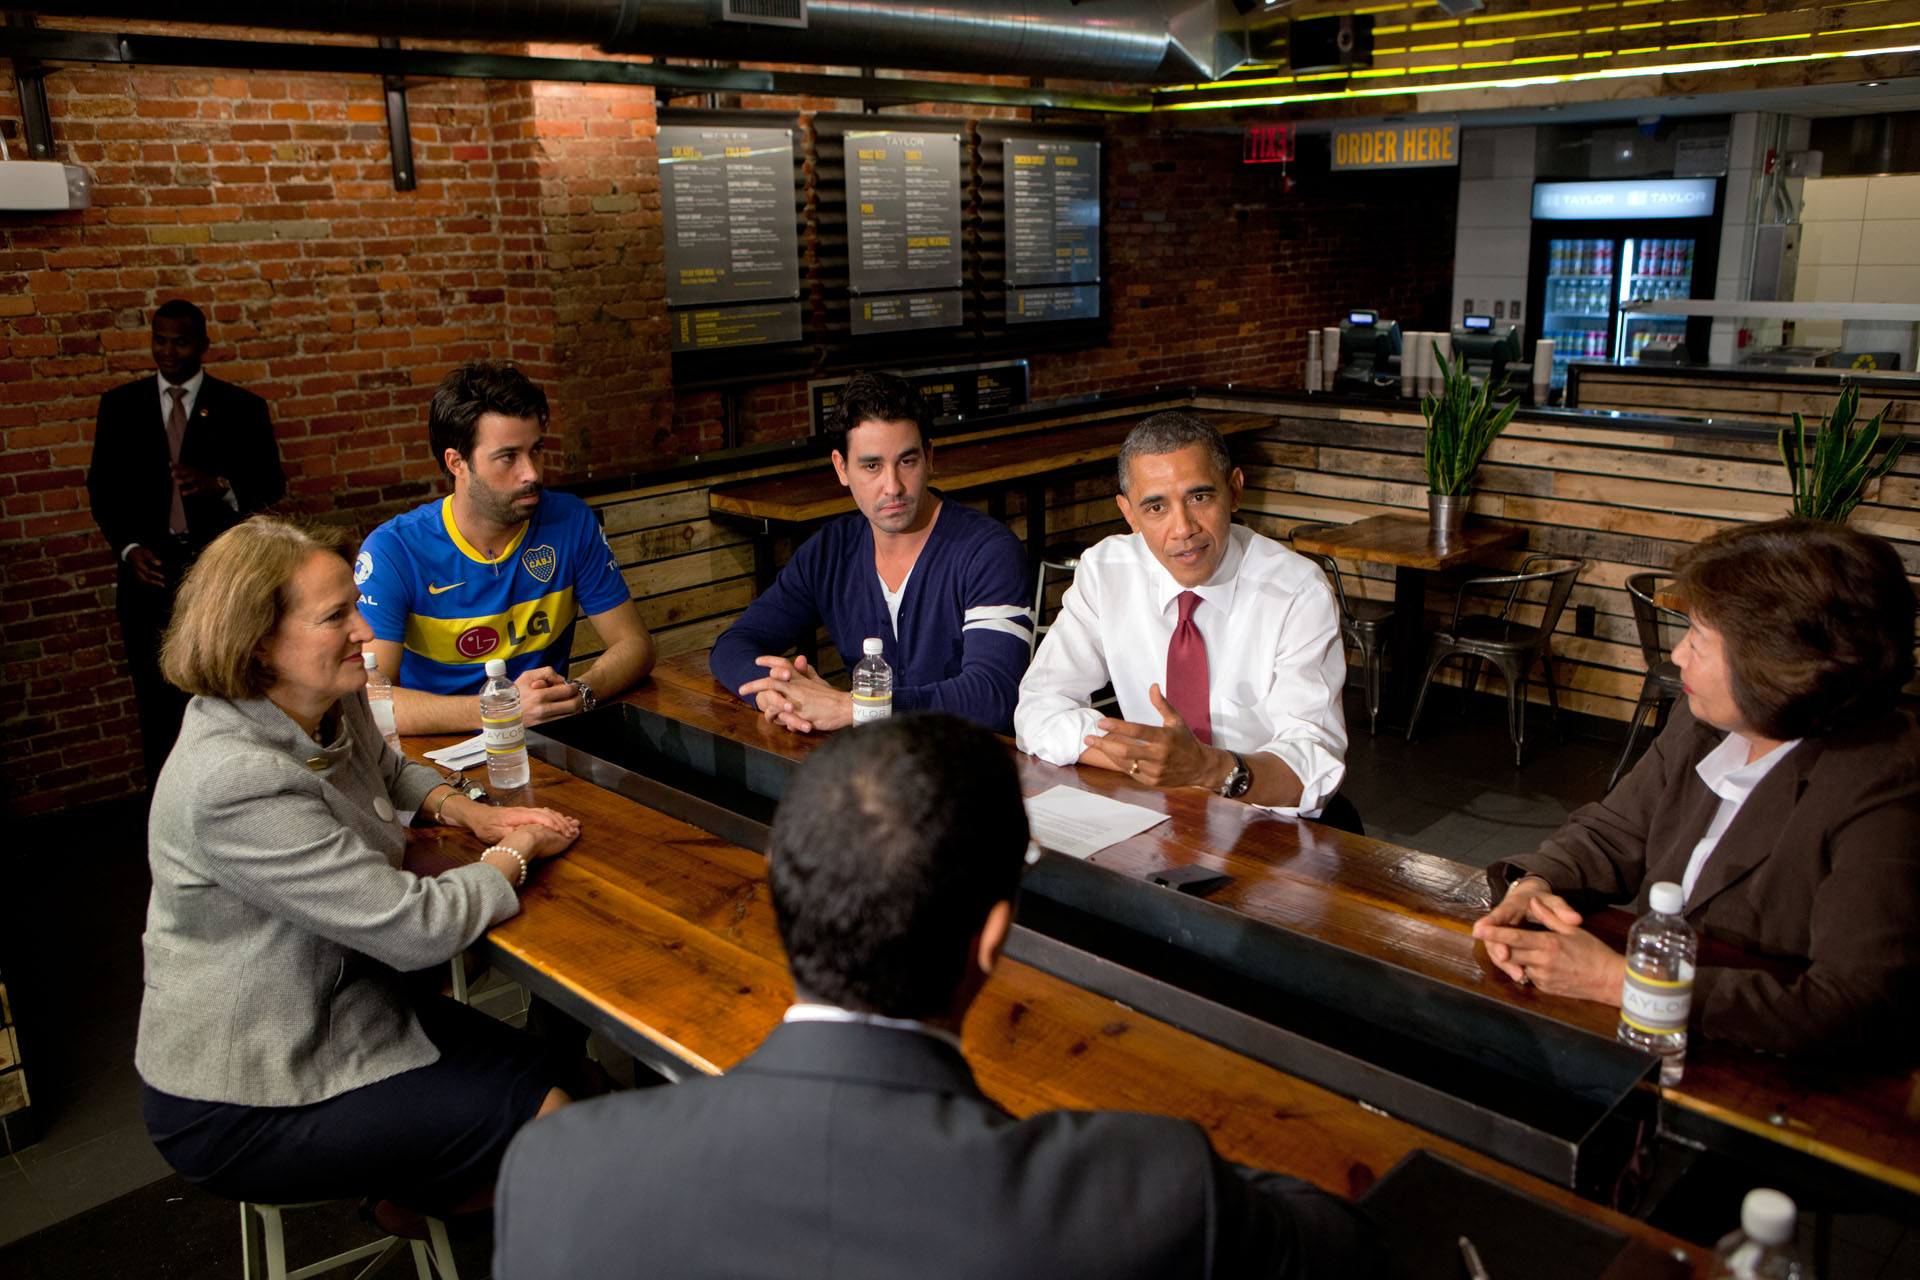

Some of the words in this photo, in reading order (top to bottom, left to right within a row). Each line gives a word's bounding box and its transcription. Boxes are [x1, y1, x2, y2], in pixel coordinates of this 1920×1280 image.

[885, 135, 924, 147] TAYLOR
[1336, 129, 1397, 165] ORDER
[1403, 127, 1453, 162] HERE
[1651, 191, 1706, 204] TAYLOR
[529, 556, 552, 569] CABJ
[507, 610, 551, 647] LG
